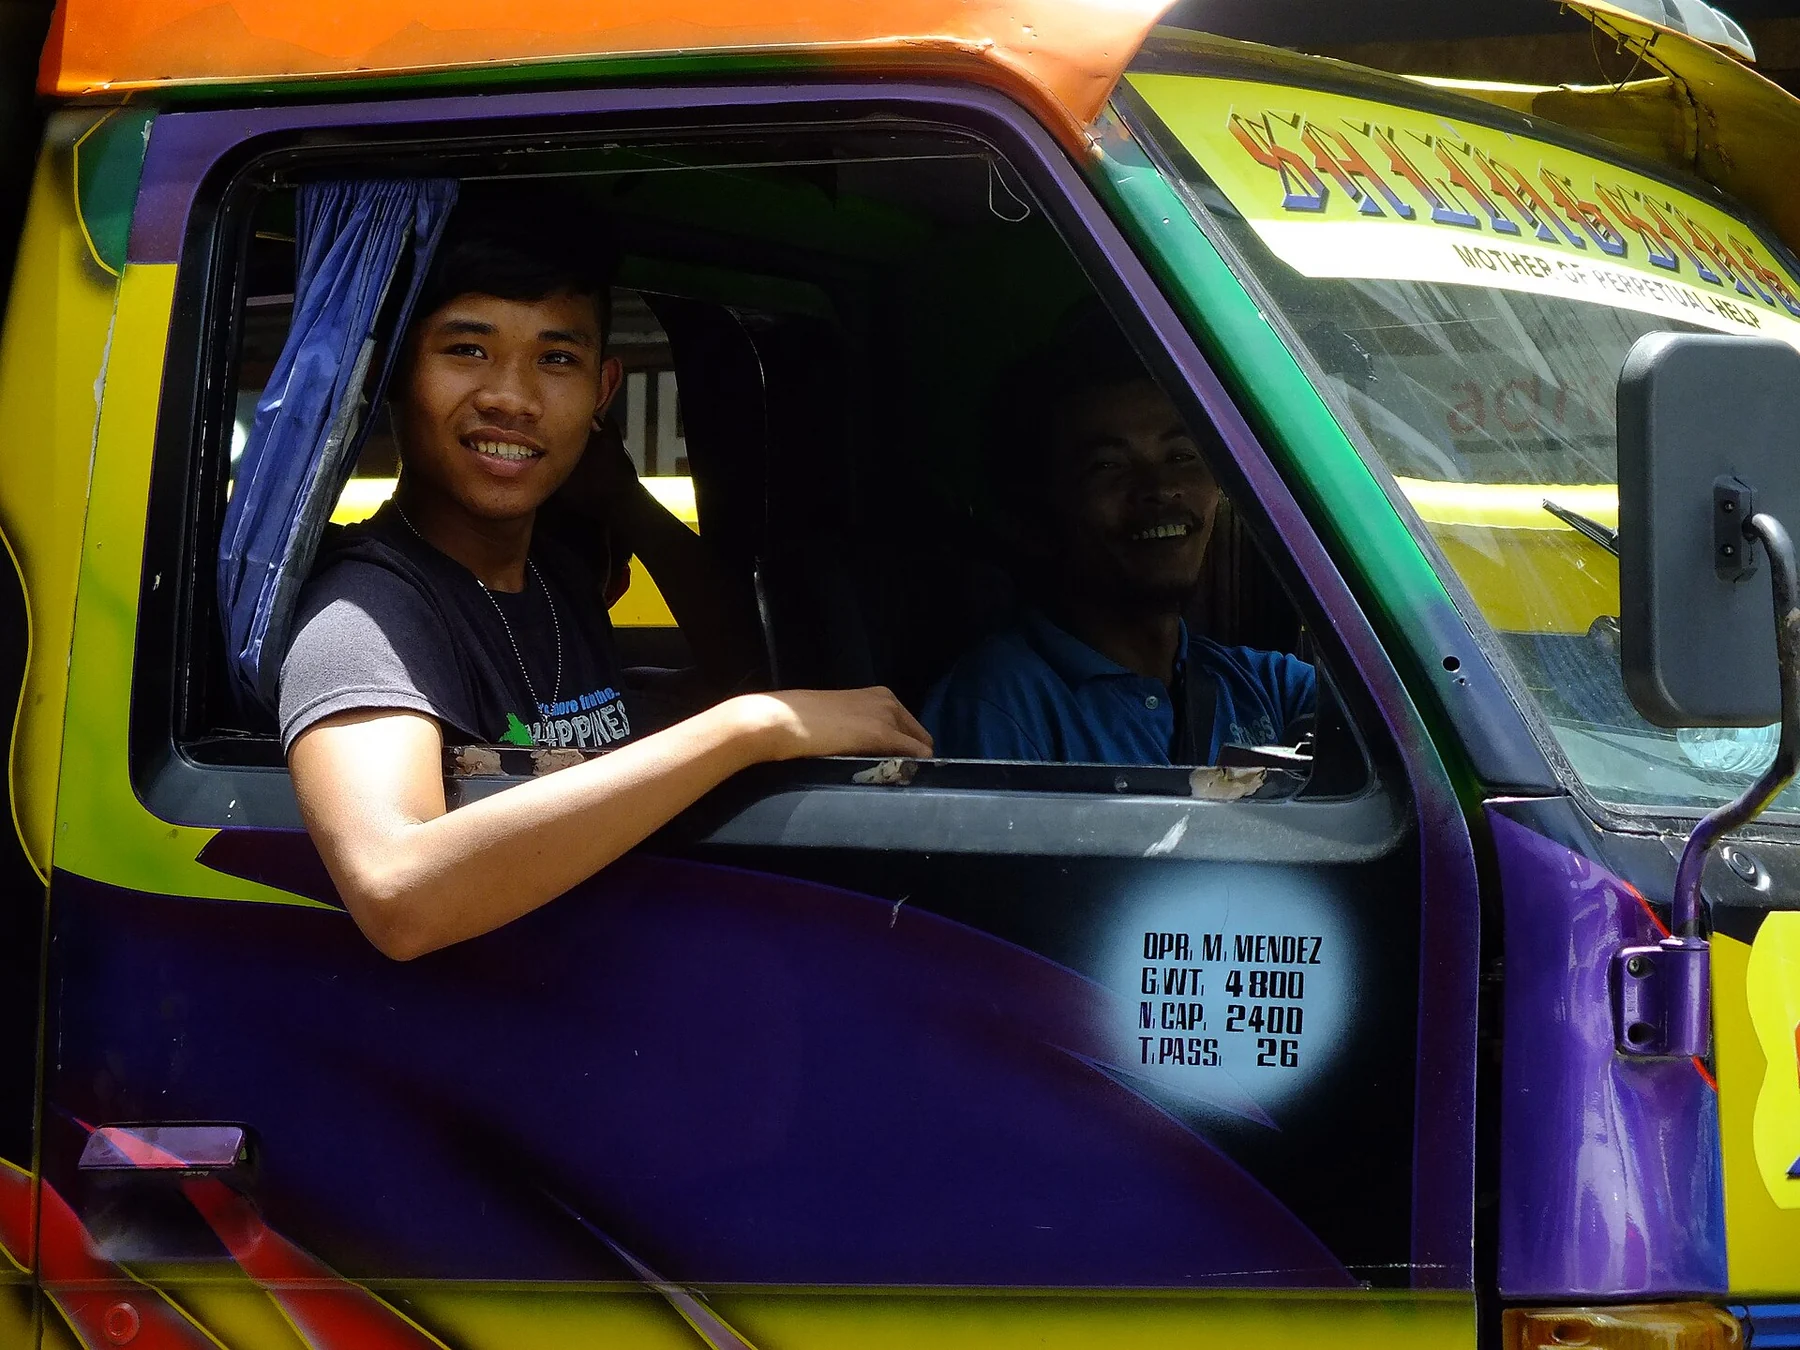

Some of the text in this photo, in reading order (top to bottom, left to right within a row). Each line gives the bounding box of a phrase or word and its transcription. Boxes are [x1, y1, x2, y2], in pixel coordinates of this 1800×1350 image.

[1452, 244, 1552, 278] MOTHER
[1592, 269, 1715, 315] PERPETUAL
[1708, 296, 1762, 329] HELP
[1233, 935, 1323, 965] MENDEZ
[1225, 970, 1304, 999] 4800
[1225, 1004, 1303, 1035] 2400
[1257, 1038, 1299, 1068] 26
